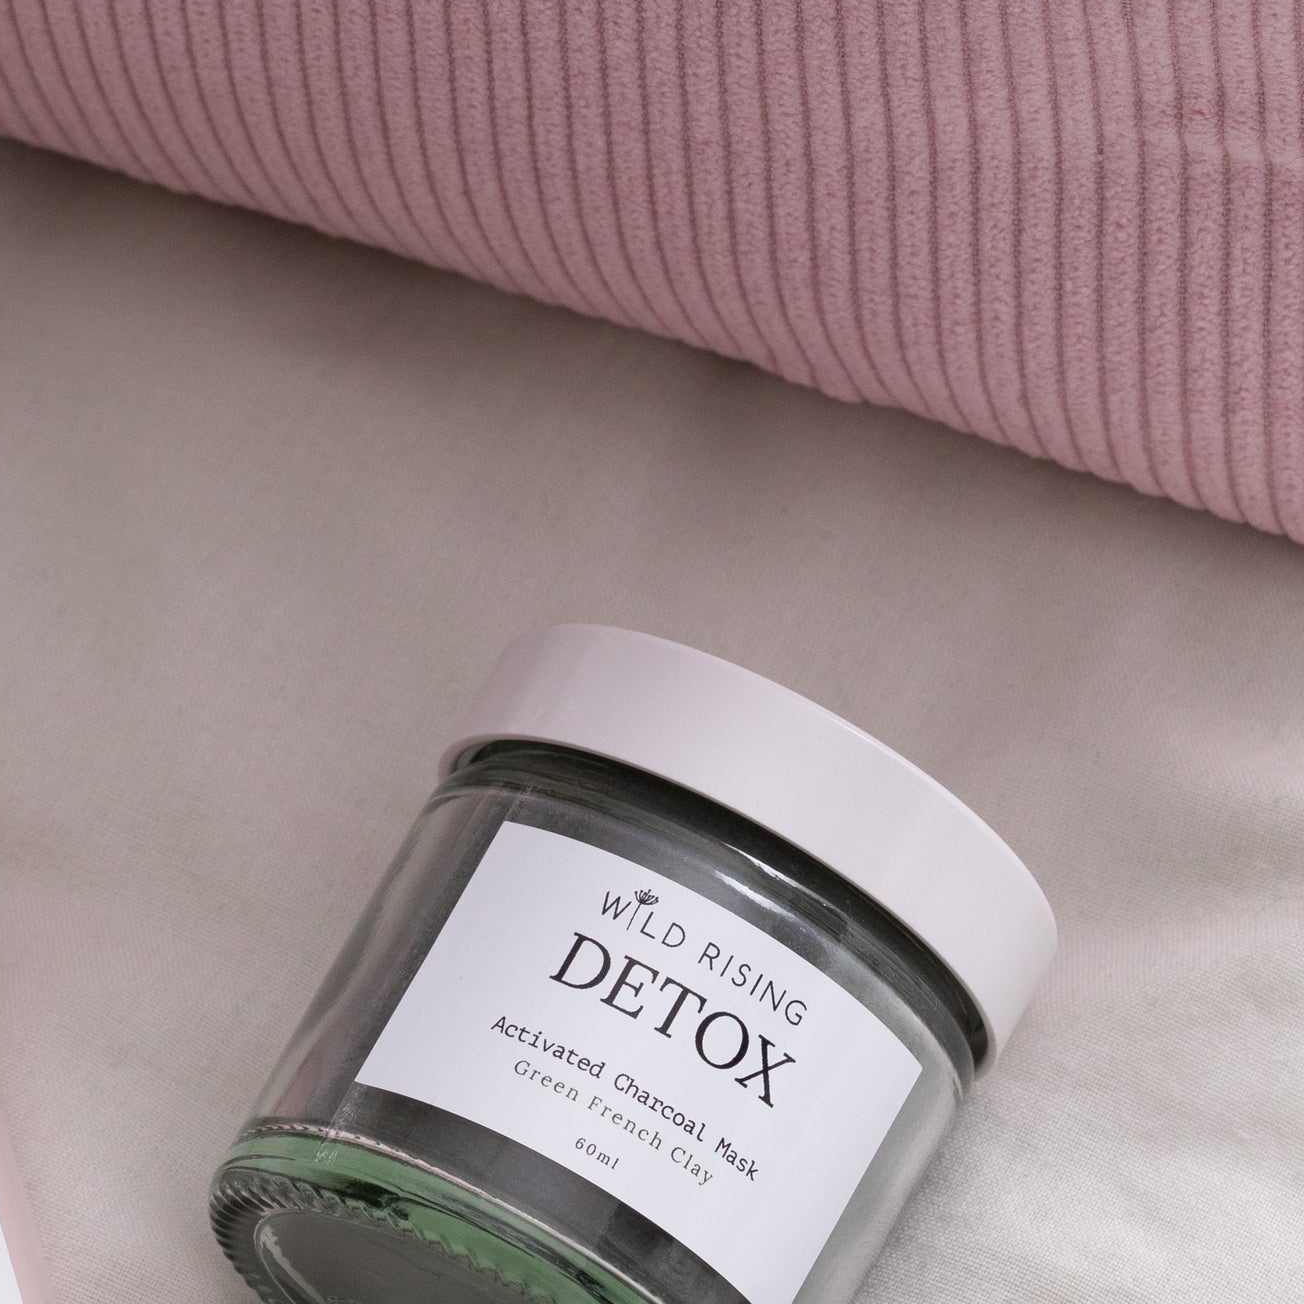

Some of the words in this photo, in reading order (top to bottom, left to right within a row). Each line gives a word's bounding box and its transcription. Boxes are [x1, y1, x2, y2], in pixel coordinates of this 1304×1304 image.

[549, 932, 796, 1108] DETOX
[601, 888, 686, 948] WILD
[698, 943, 807, 1026] RISING
[491, 1016, 605, 1080] Activated
[613, 1073, 707, 1143] Charcoal
[715, 1137, 758, 1182] Mask
[514, 1060, 578, 1101] Green
[587, 1096, 662, 1151] French
[670, 1146, 714, 1187] Clay
[575, 1137, 620, 1170] 60ml
